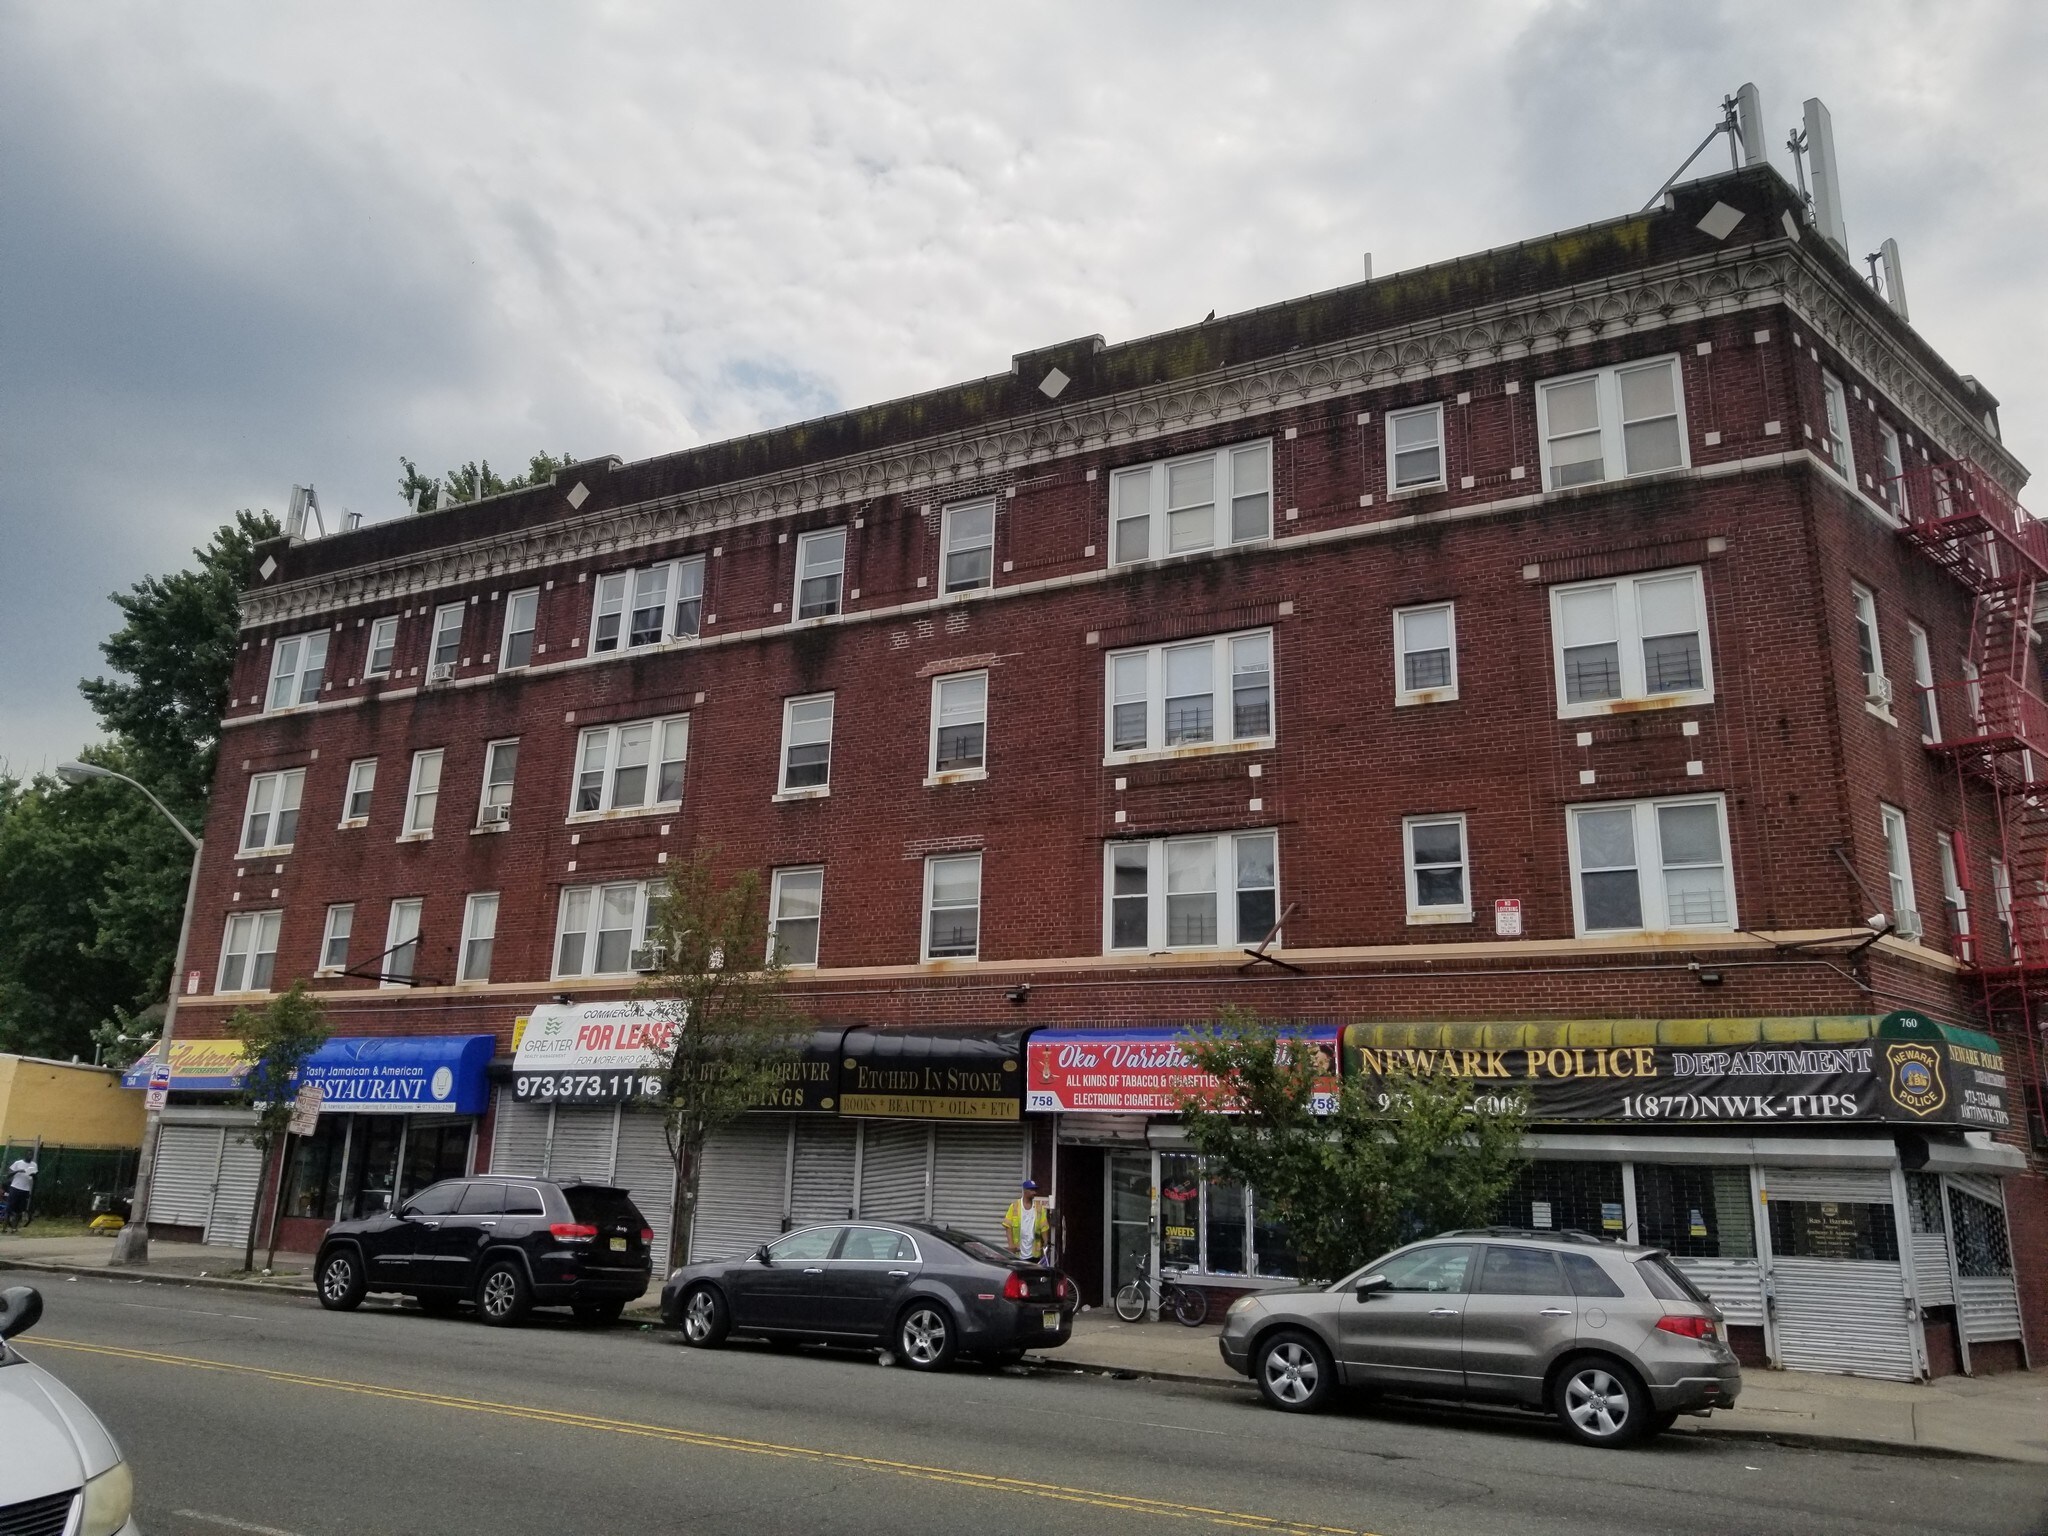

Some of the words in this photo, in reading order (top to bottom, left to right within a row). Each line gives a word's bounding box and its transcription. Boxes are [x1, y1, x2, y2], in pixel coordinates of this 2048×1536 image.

[583, 1009, 645, 1019] COMMERCIAL
[1900, 1018, 1918, 1028] 760
[575, 1024, 614, 1051] FOR
[614, 1023, 676, 1050] LEASE
[525, 1039, 573, 1052] GREATER
[576, 1056, 592, 1065] FOR
[593, 1056, 616, 1064] MORE
[616, 1055, 635, 1064] INFO
[1058, 1044, 1099, 1068] Oka
[1359, 1047, 1511, 1077] NEWARK
[1524, 1047, 1658, 1078] POLICE
[1672, 1048, 1873, 1077] DEPARTMENT
[1893, 1050, 1935, 1068] NEWARK
[1948, 1044, 1981, 1067] NEWARK
[1980, 1051, 2005, 1071] POLICE
[306, 1066, 326, 1078] Tasty
[328, 1066, 370, 1076] Jamaican
[373, 1066, 379, 1076] &
[382, 1066, 423, 1076] American
[517, 1076, 662, 1097] 973.373.1116
[1066, 1074, 1081, 1087] ALL
[1082, 1074, 1107, 1087] KINDS
[1109, 1074, 1120, 1087] OF
[1121, 1075, 1157, 1088] TABACCO
[1160, 1075, 1166, 1087] &
[1031, 1096, 1053, 1107] 758
[1073, 1093, 1122, 1106] ELECTRONIC
[1125, 1094, 1175, 1107] CIGARETTES
[1310, 1098, 1334, 1110] 758
[1622, 1092, 1858, 1119] 1(877)NWK-TIPS
[1900, 1090, 1938, 1107] POLICE
[843, 1097, 876, 1111] BOOKS
[888, 1099, 935, 1114] BEAUTY
[949, 1100, 977, 1115] OILS
[990, 1102, 1014, 1116] ETC
[1165, 1226, 1195, 1237] SWEETS
